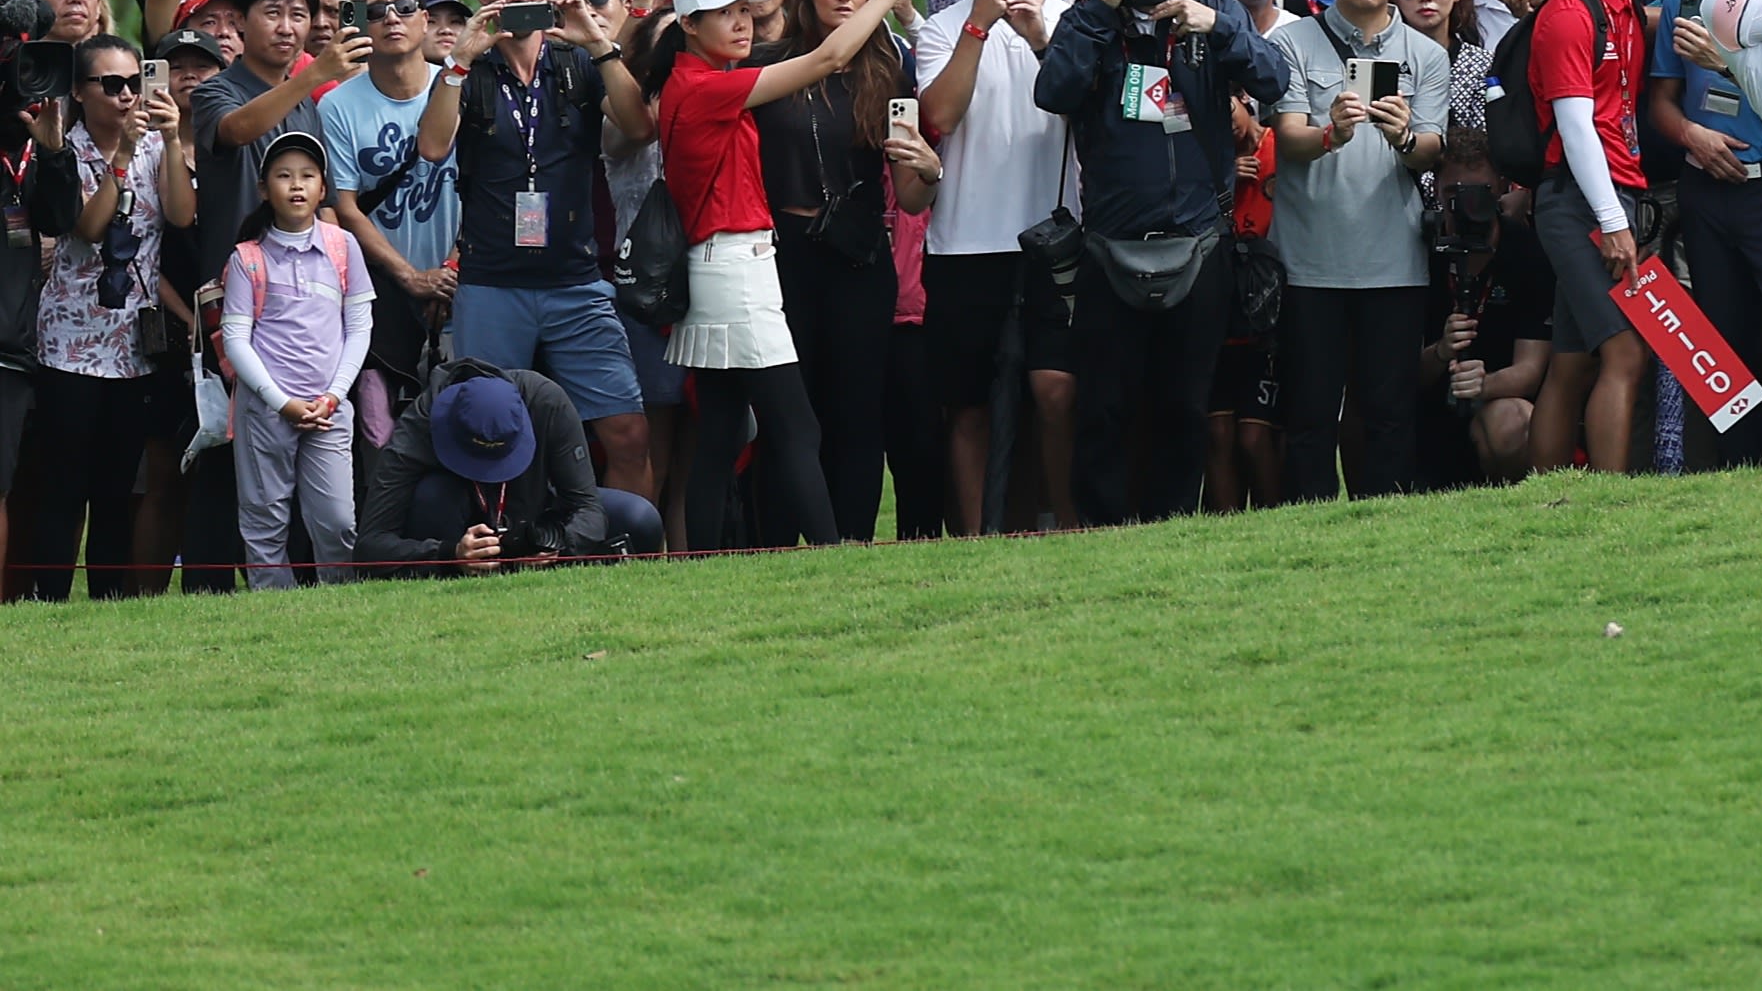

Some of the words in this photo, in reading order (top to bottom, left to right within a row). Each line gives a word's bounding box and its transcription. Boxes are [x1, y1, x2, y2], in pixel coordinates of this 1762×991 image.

[1129, 64, 1142, 85] 090
[1126, 86, 1140, 119] Media
[376, 166, 457, 229] Golf
[1624, 269, 1658, 298] Plee
[1644, 290, 1731, 393] QUIET
